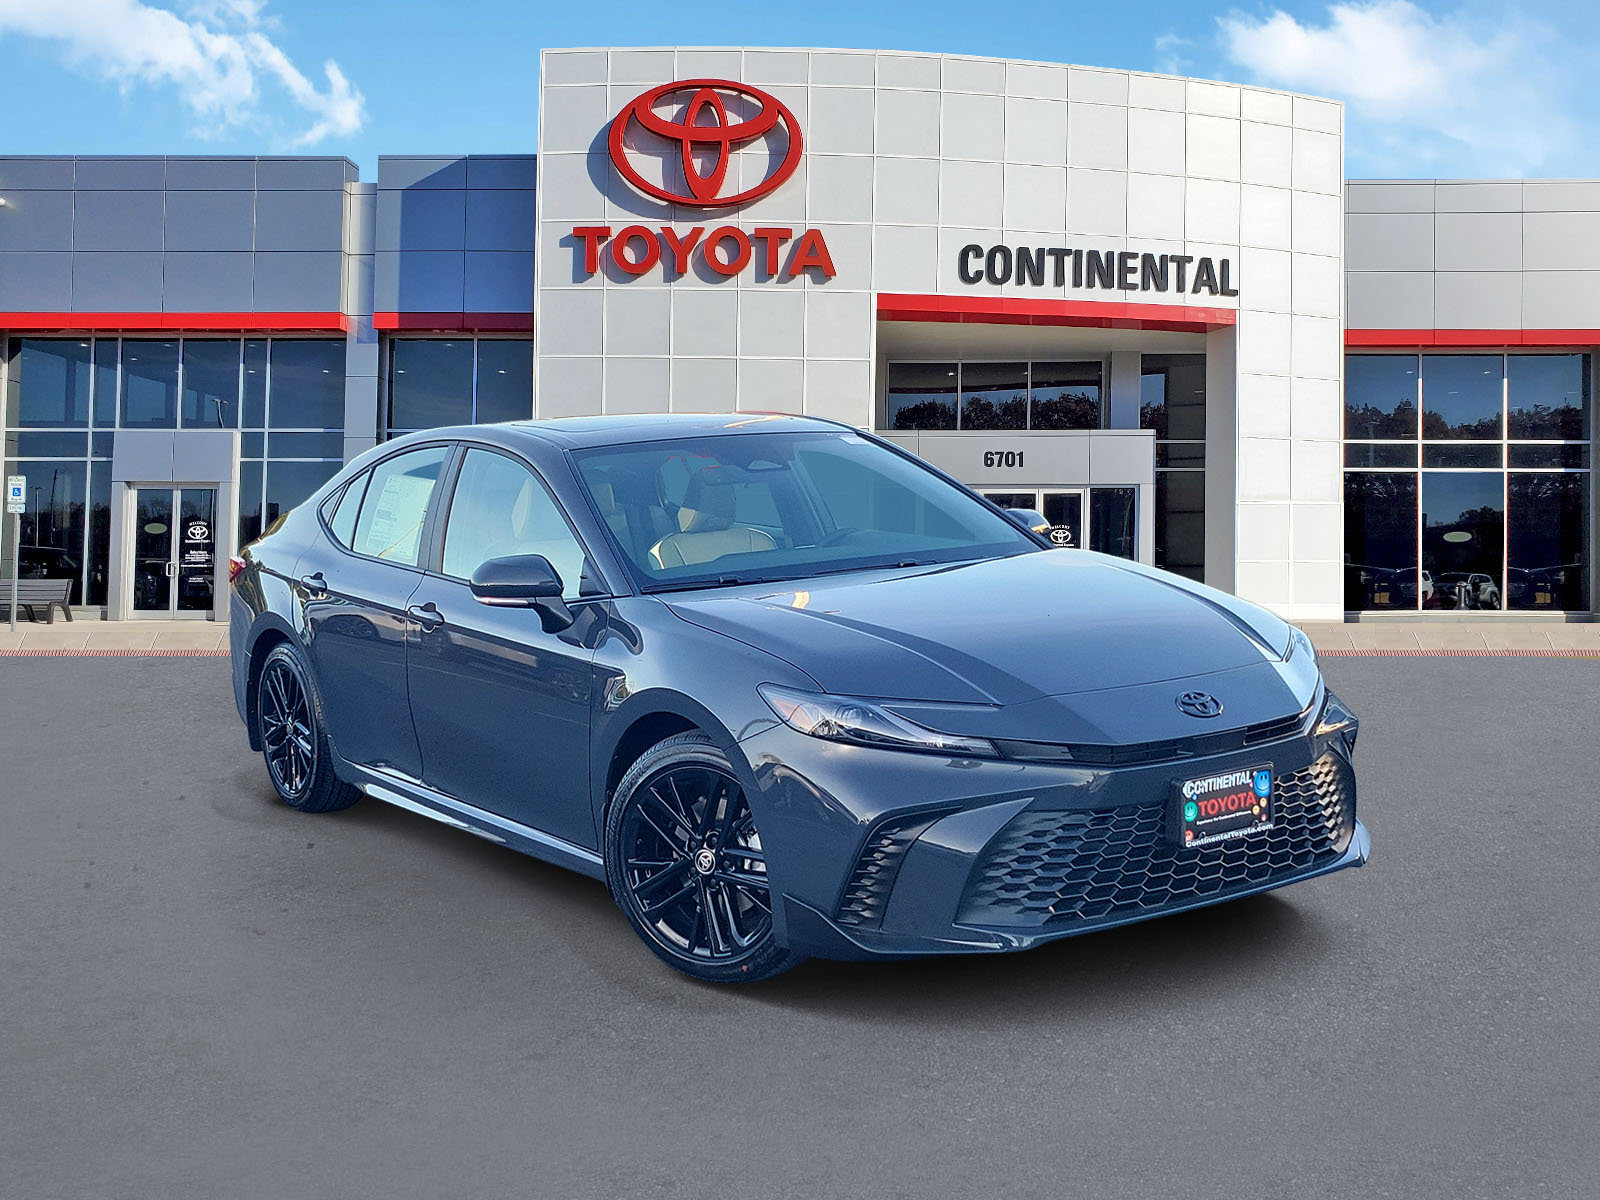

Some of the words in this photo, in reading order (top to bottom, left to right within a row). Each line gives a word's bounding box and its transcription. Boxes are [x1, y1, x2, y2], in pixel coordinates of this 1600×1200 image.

[573, 225, 837, 277] TOYOTA
[958, 244, 1239, 297] CONTINENTAL
[983, 451, 1024, 468] 6701
[1183, 771, 1252, 798] CONTINENTAL
[1198, 791, 1257, 817] TOYOTA
[1185, 823, 1274, 848] ContinentalToyota.com
